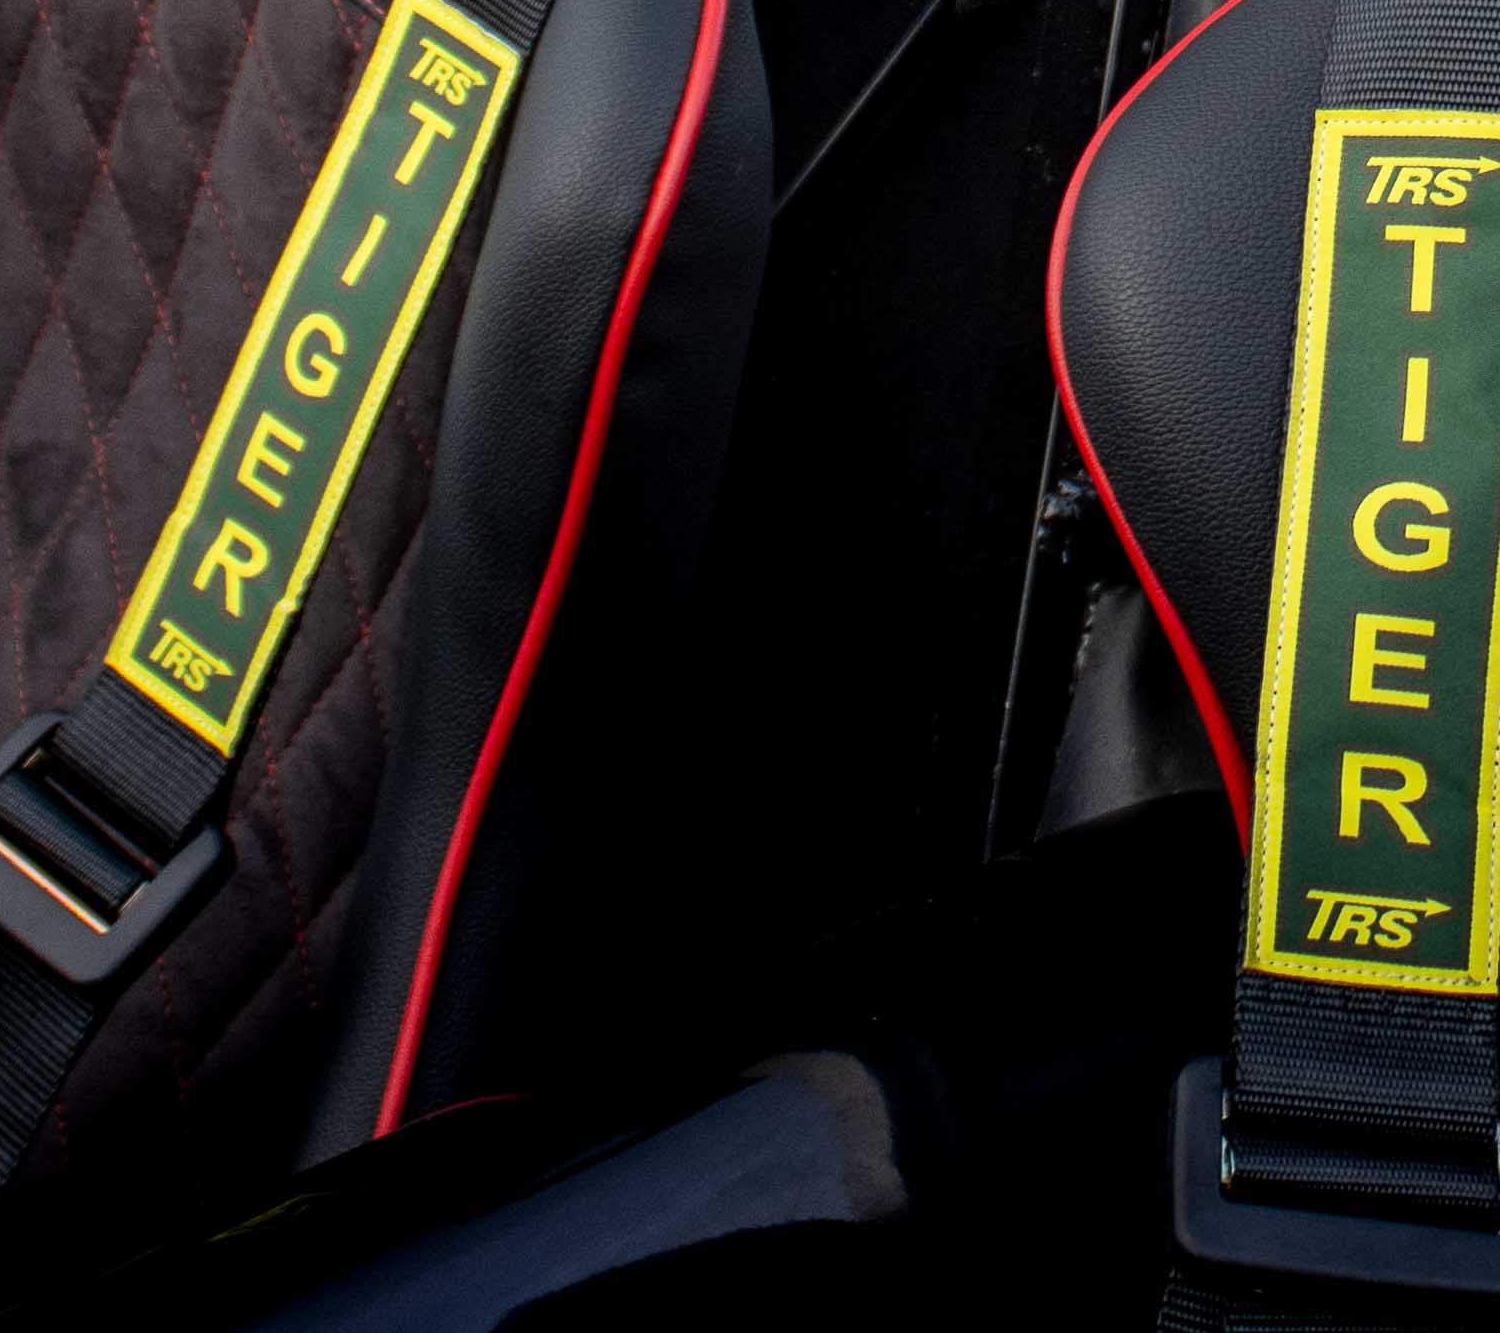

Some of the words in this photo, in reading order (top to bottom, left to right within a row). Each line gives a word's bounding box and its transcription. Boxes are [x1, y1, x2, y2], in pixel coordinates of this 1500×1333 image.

[406, 36, 486, 107] TRS
[192, 99, 455, 618] TIGER
[1338, 223, 1467, 846] TIGER
[148, 619, 233, 693] TRS
[1306, 889, 1451, 949] TRS
